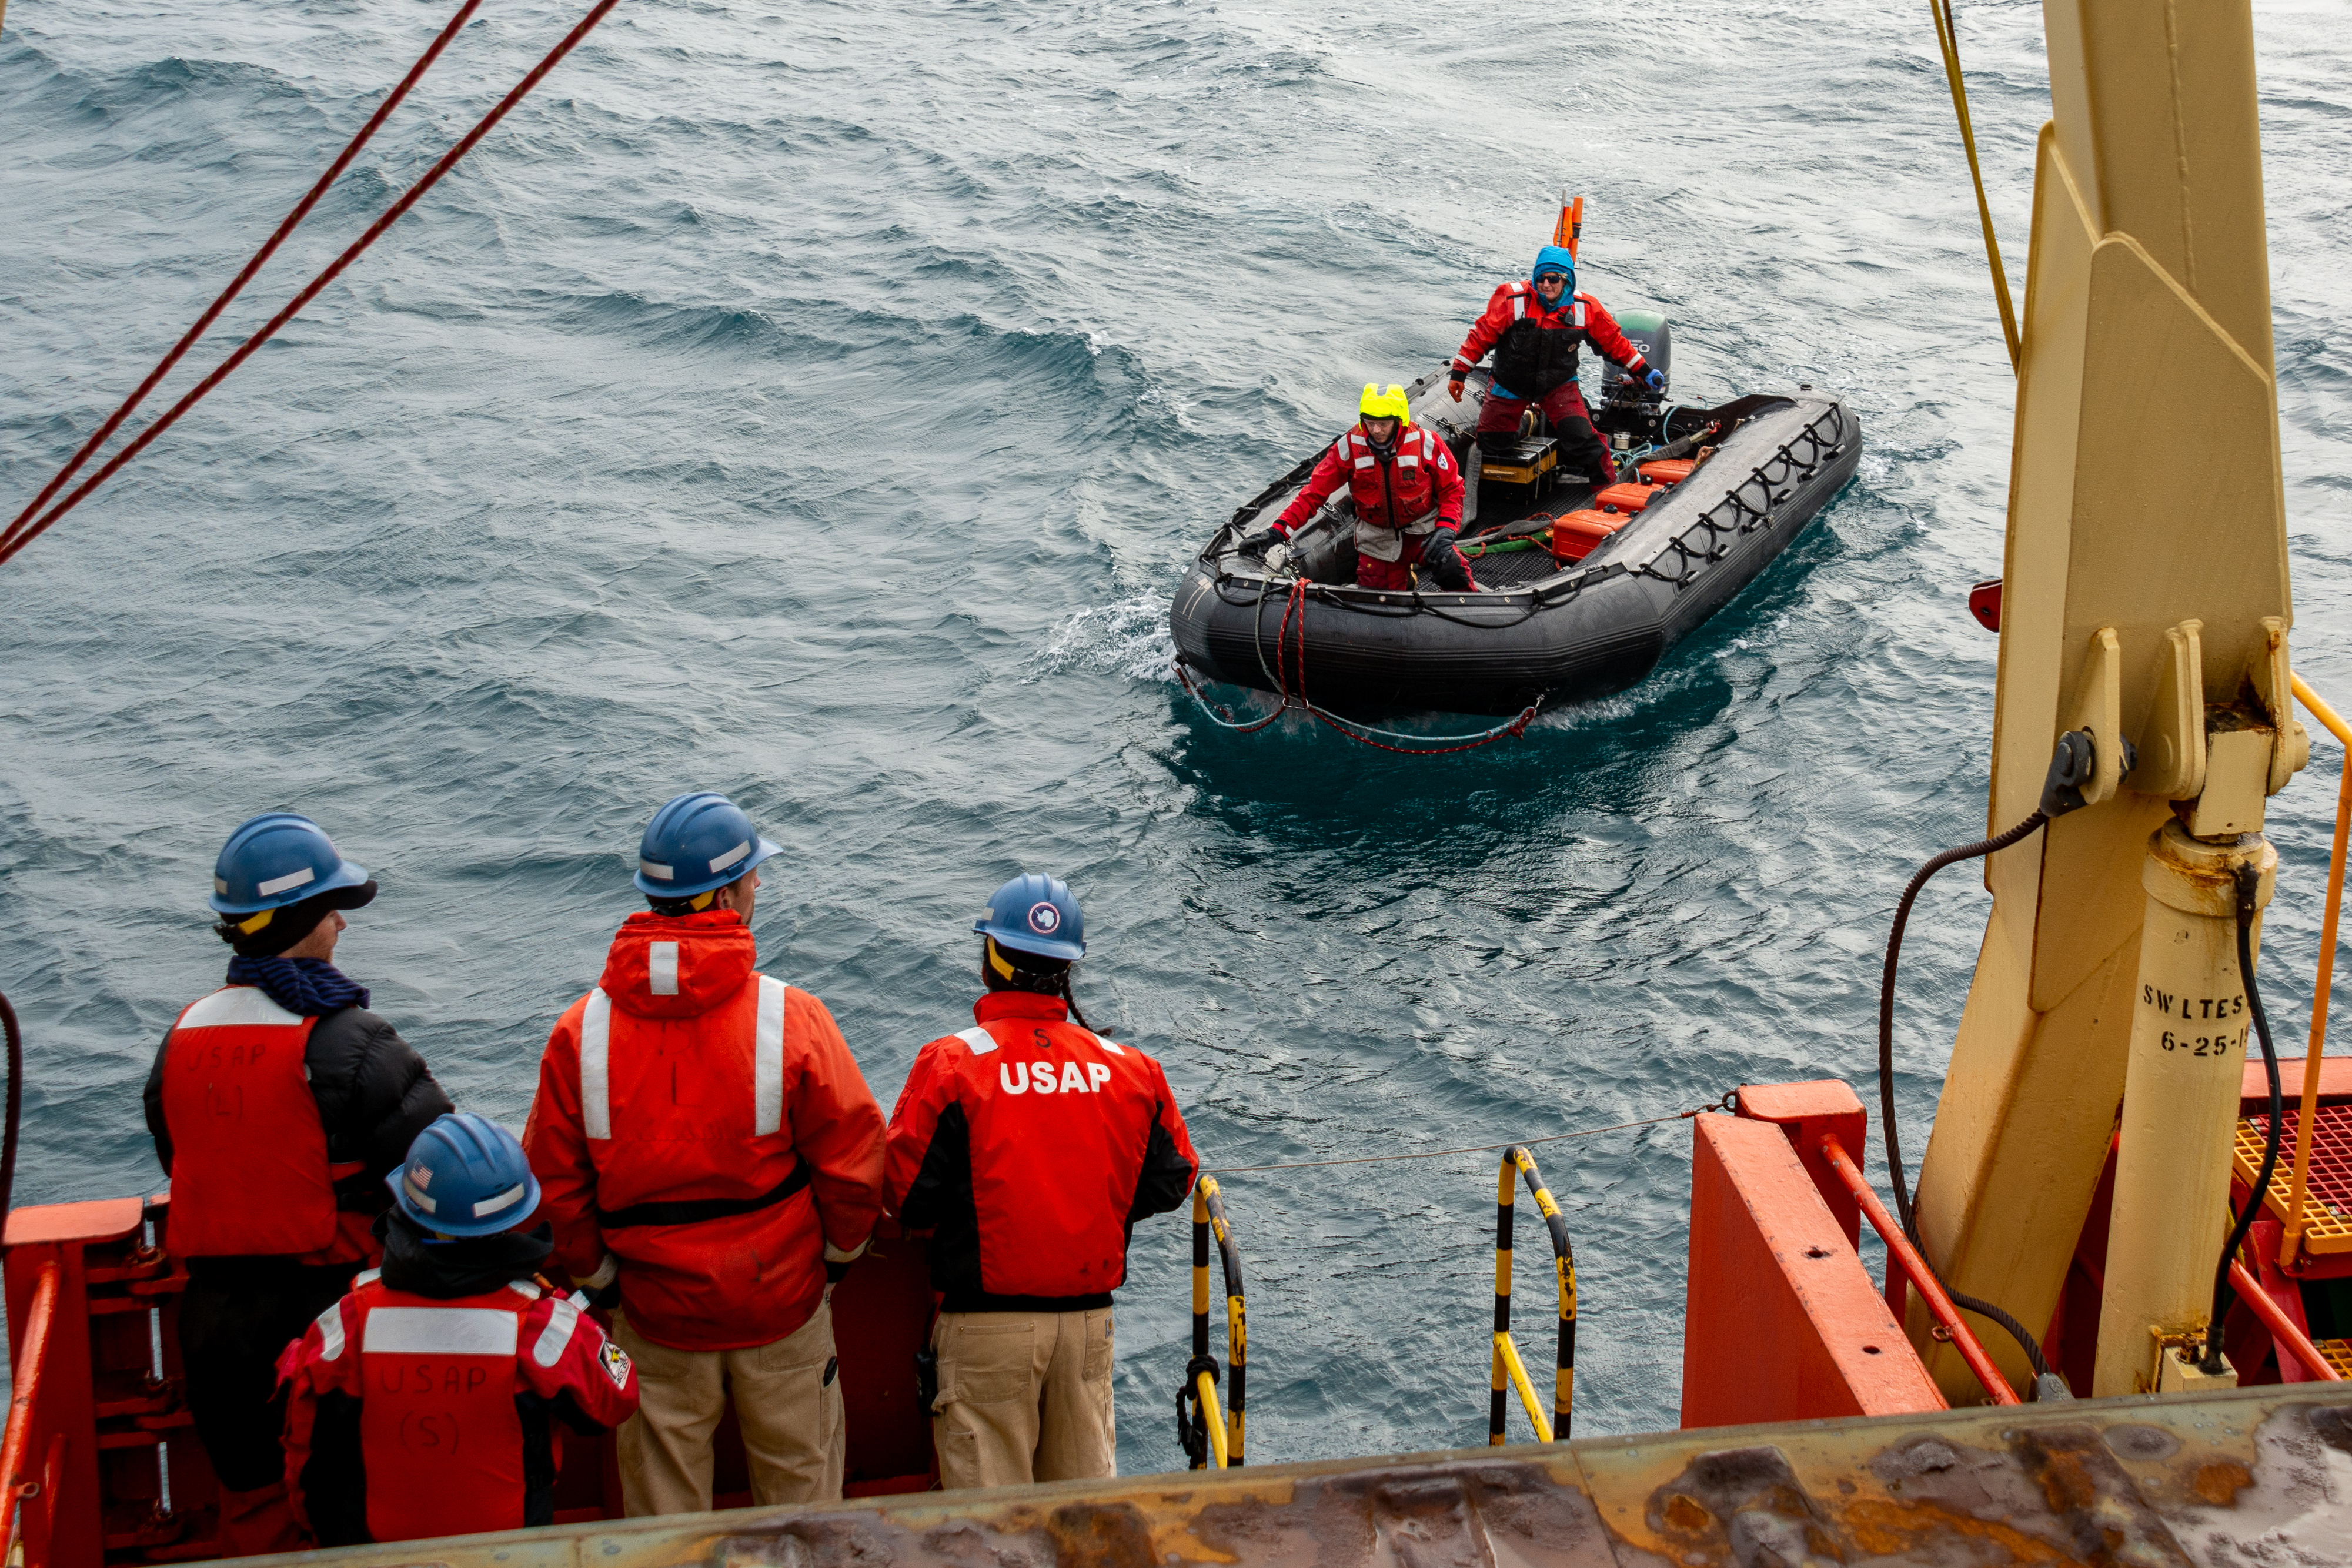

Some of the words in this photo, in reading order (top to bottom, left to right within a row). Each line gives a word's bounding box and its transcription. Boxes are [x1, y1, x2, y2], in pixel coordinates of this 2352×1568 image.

[2199, 994, 2249, 1019] TES
[1033, 1028, 1051, 1048] S
[187, 1043, 266, 1072] USAP
[1000, 1061, 1111, 1094] USAP
[381, 1364, 486, 1394] USAP
[400, 1411, 459, 1455] (S)
